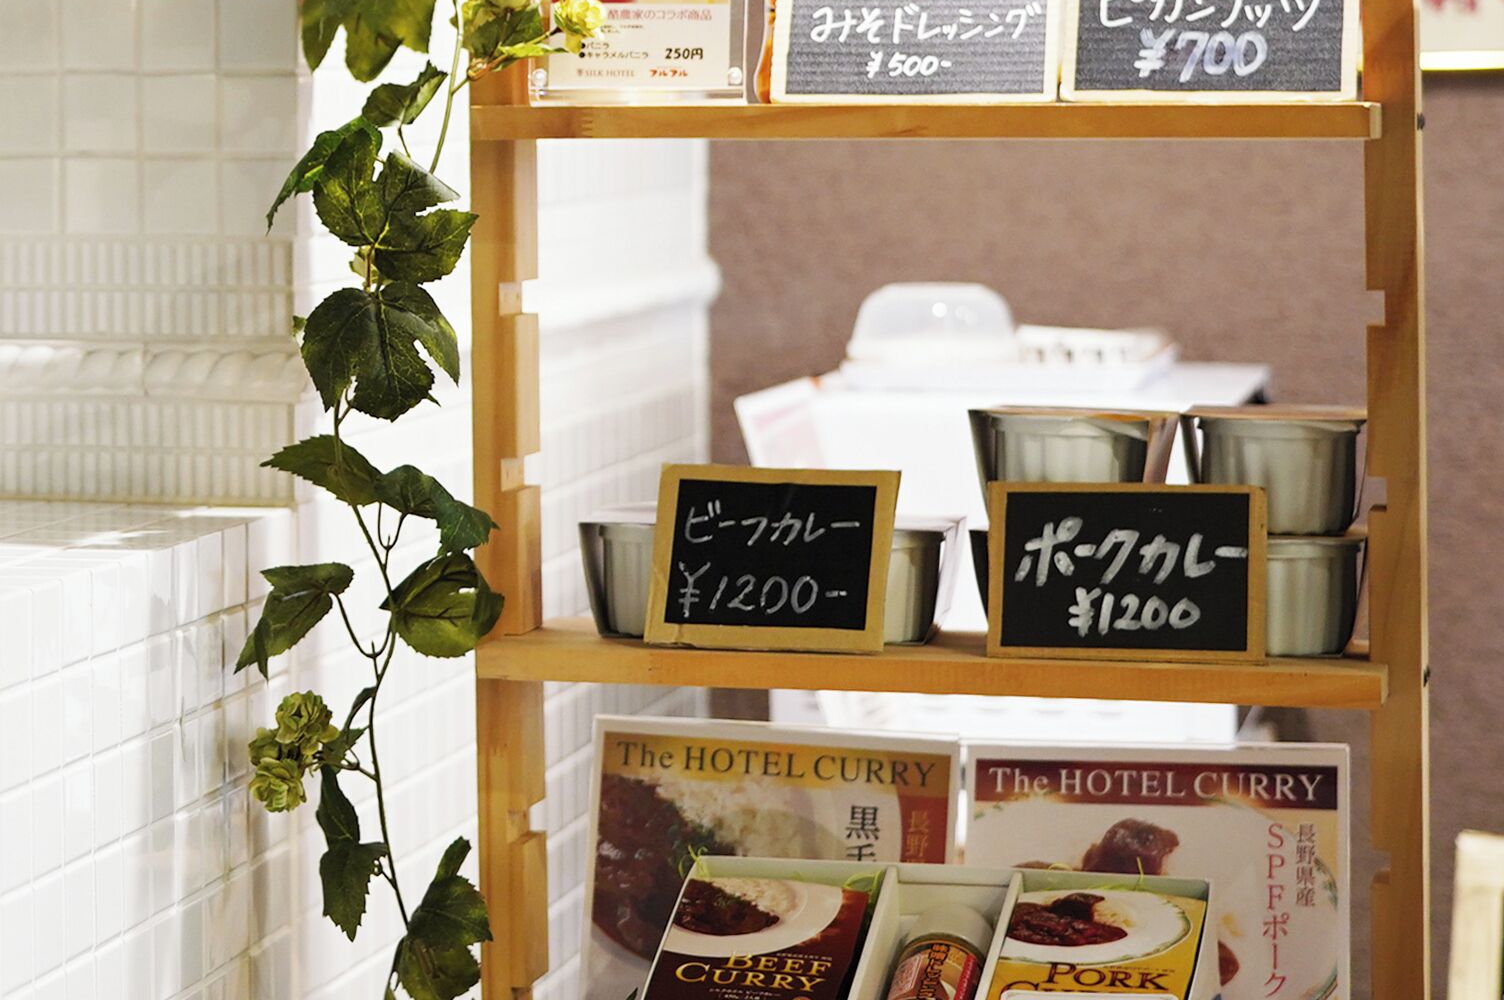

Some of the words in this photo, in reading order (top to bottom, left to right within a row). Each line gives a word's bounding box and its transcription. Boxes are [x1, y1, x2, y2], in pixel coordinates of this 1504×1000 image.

[810, 1, 1043, 44] みそドレッシング
[664, 47, 705, 60] 250円
[1133, 28, 1268, 83] ¥700
[684, 499, 861, 547] ビーフカレー
[1014, 516, 1248, 588] ポークカレー
[1068, 586, 1202, 638] ¥1200
[617, 740, 675, 769] The
[683, 745, 805, 779] HOTEL
[813, 754, 936, 788] CURRY
[989, 766, 1050, 794] The
[1059, 768, 1186, 798] HOTEL
[1193, 770, 1324, 801] CURRY
[906, 810, 931, 864] 長野
[1296, 823, 1317, 908] 長野県産
[675, 962, 827, 993] CURRY
[724, 952, 833, 977] BEEF
[1045, 961, 1171, 992] PORK
